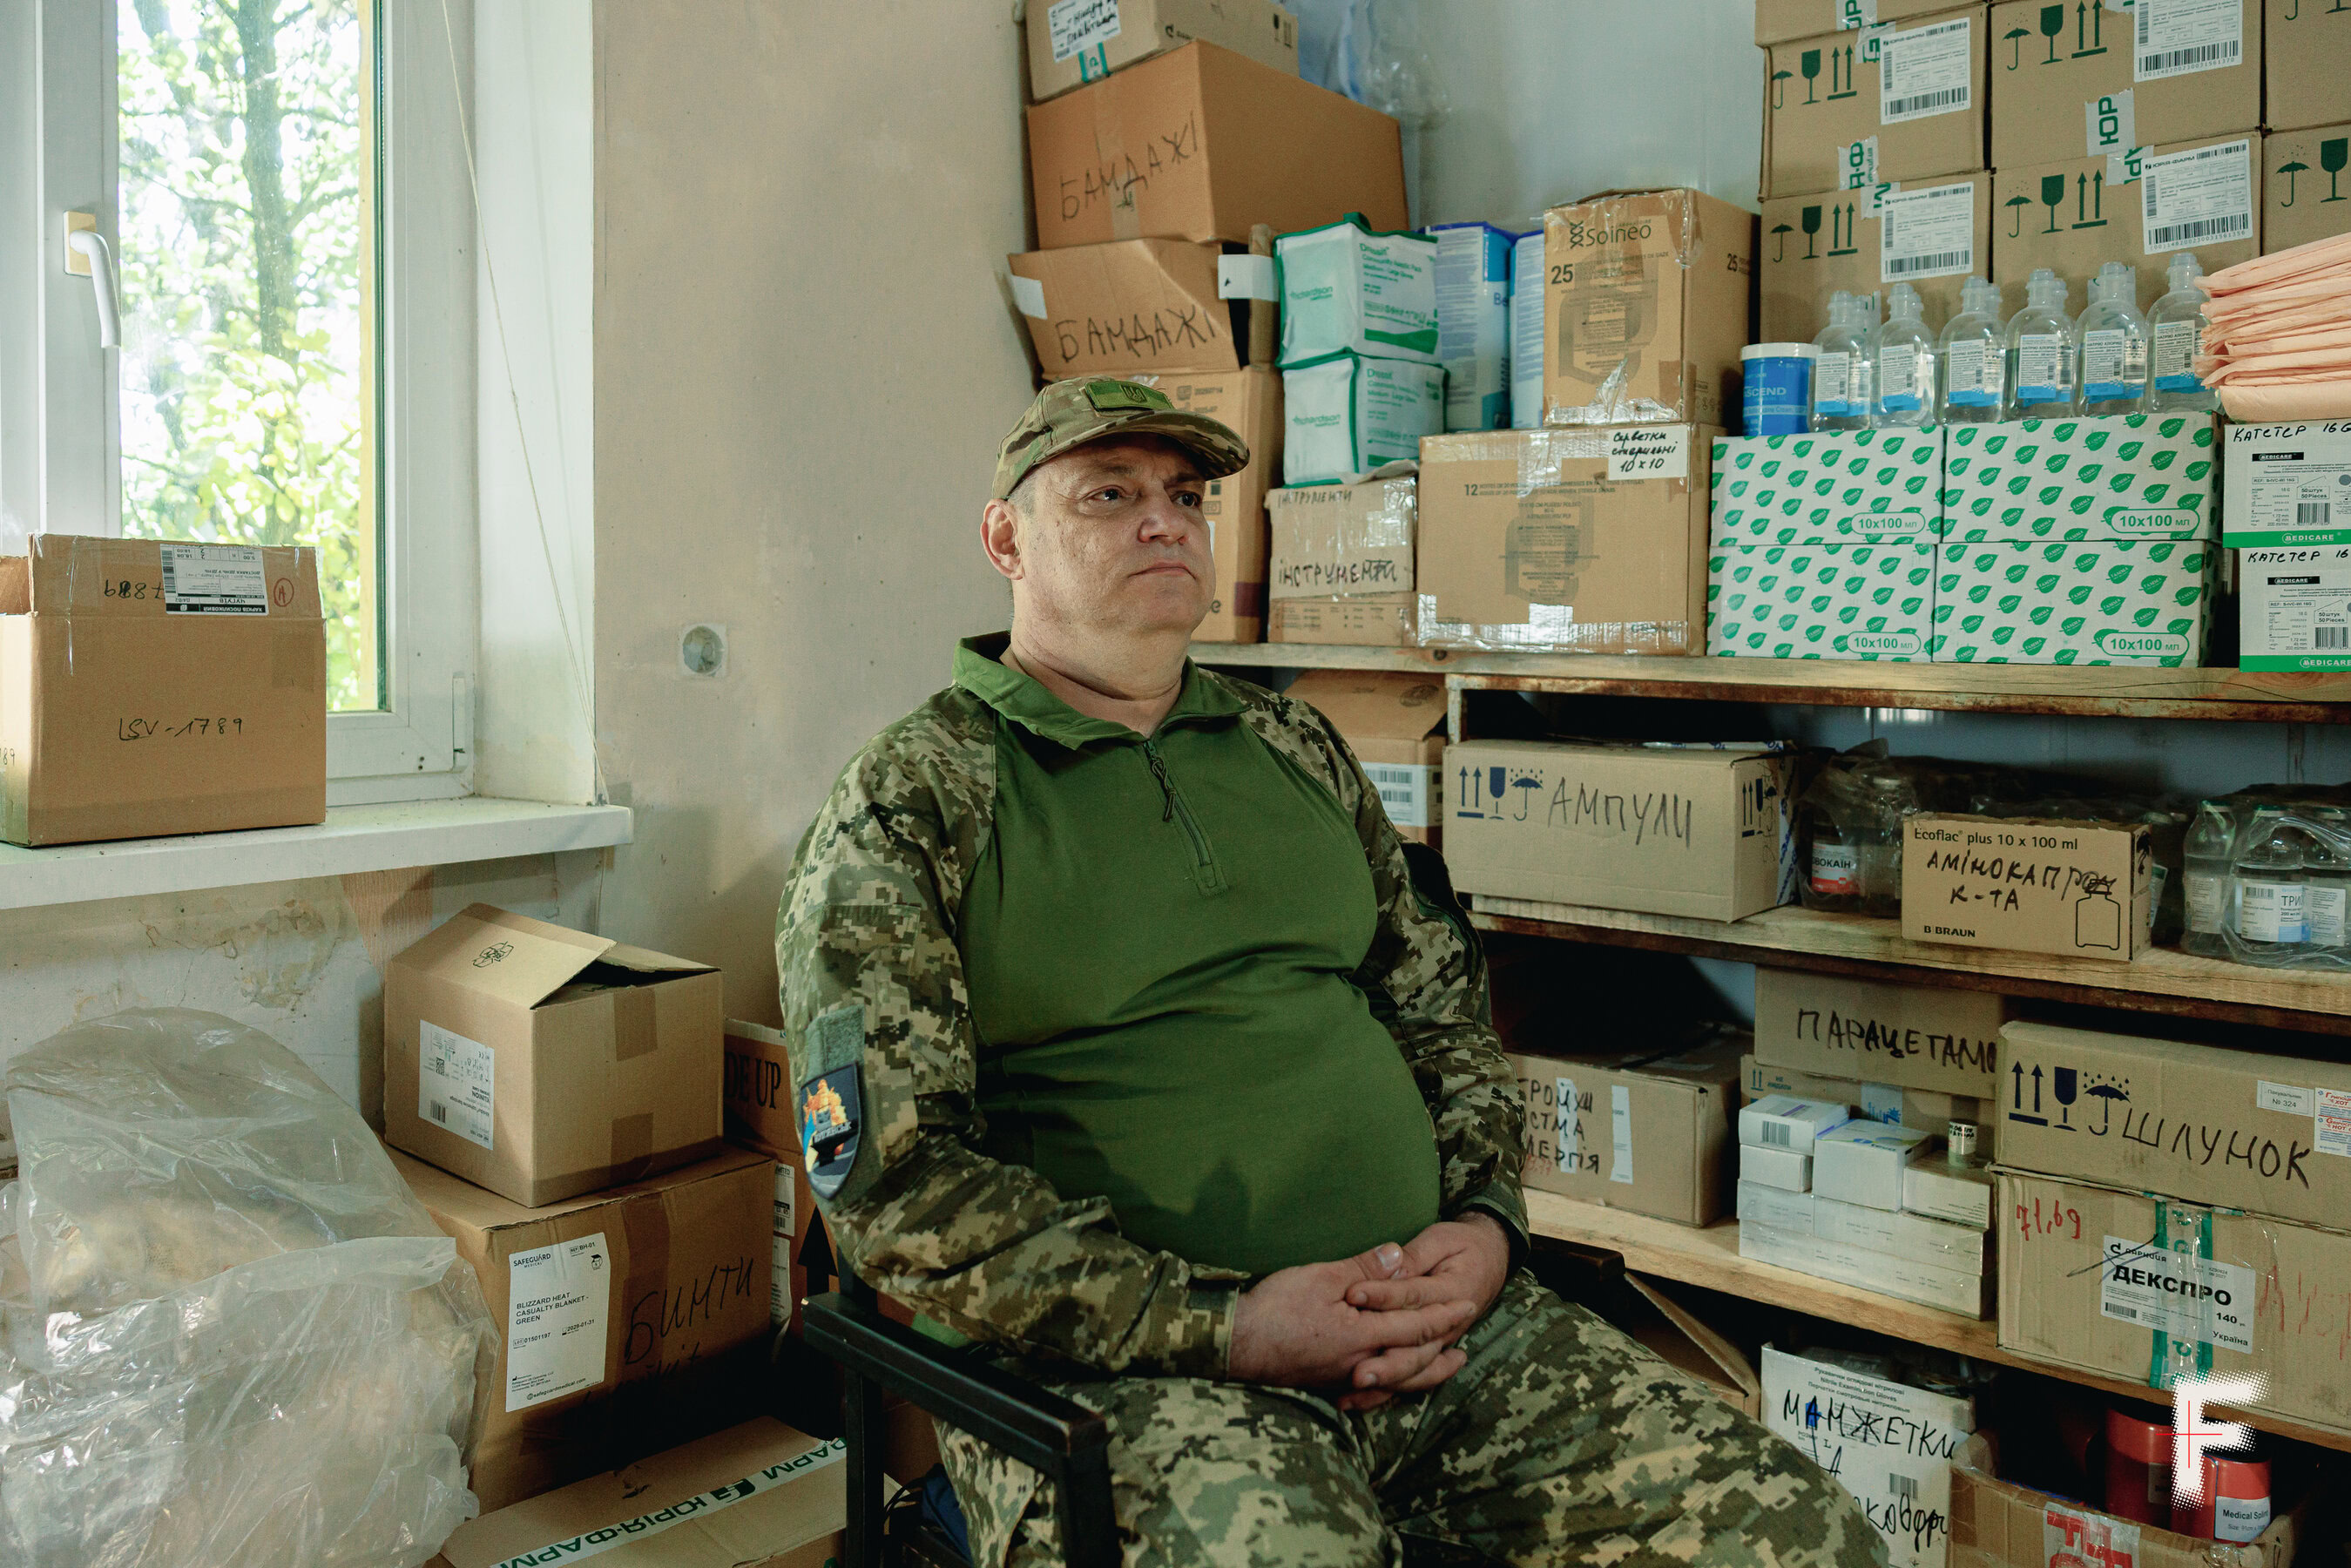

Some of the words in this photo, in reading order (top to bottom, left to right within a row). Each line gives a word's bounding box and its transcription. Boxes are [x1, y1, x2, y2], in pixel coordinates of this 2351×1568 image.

[1726, 253, 1738, 272] 25
[1550, 263, 1574, 285] 25
[1620, 460, 1635, 472] 10
[1649, 457, 1665, 469] 10
[1464, 483, 1478, 496] 12
[1858, 517, 1902, 530] 10x100
[2119, 515, 2172, 527] 10x100
[2282, 533, 2334, 544] MEDICARE
[1854, 637, 1898, 649] 10x100
[2110, 638, 2162, 652] 10x100
[1968, 832, 1992, 846] plus
[1997, 834, 2014, 846] 10
[2018, 838, 2027, 847] x
[2031, 836, 2057, 849] 100
[2062, 839, 2078, 850] ml
[1935, 926, 1976, 938] BRAUN
[755, 1057, 781, 1110] UP
[2283, 1099, 2297, 1108] 324
[2121, 1108, 2311, 1189] ШЛУНОК
[2112, 1265, 2232, 1306] ДЕКСПРО
[516, 1304, 554, 1317] CASUALTY
[555, 1295, 585, 1309] BLANKET
[517, 1296, 551, 1309] BLIZZARD
[552, 1292, 571, 1301] HEAT
[516, 1315, 541, 1325] GREEN
[2216, 1312, 2238, 1324] 140
[2213, 1330, 2248, 1347] Україна
[2222, 1509, 2253, 1520] Medical
